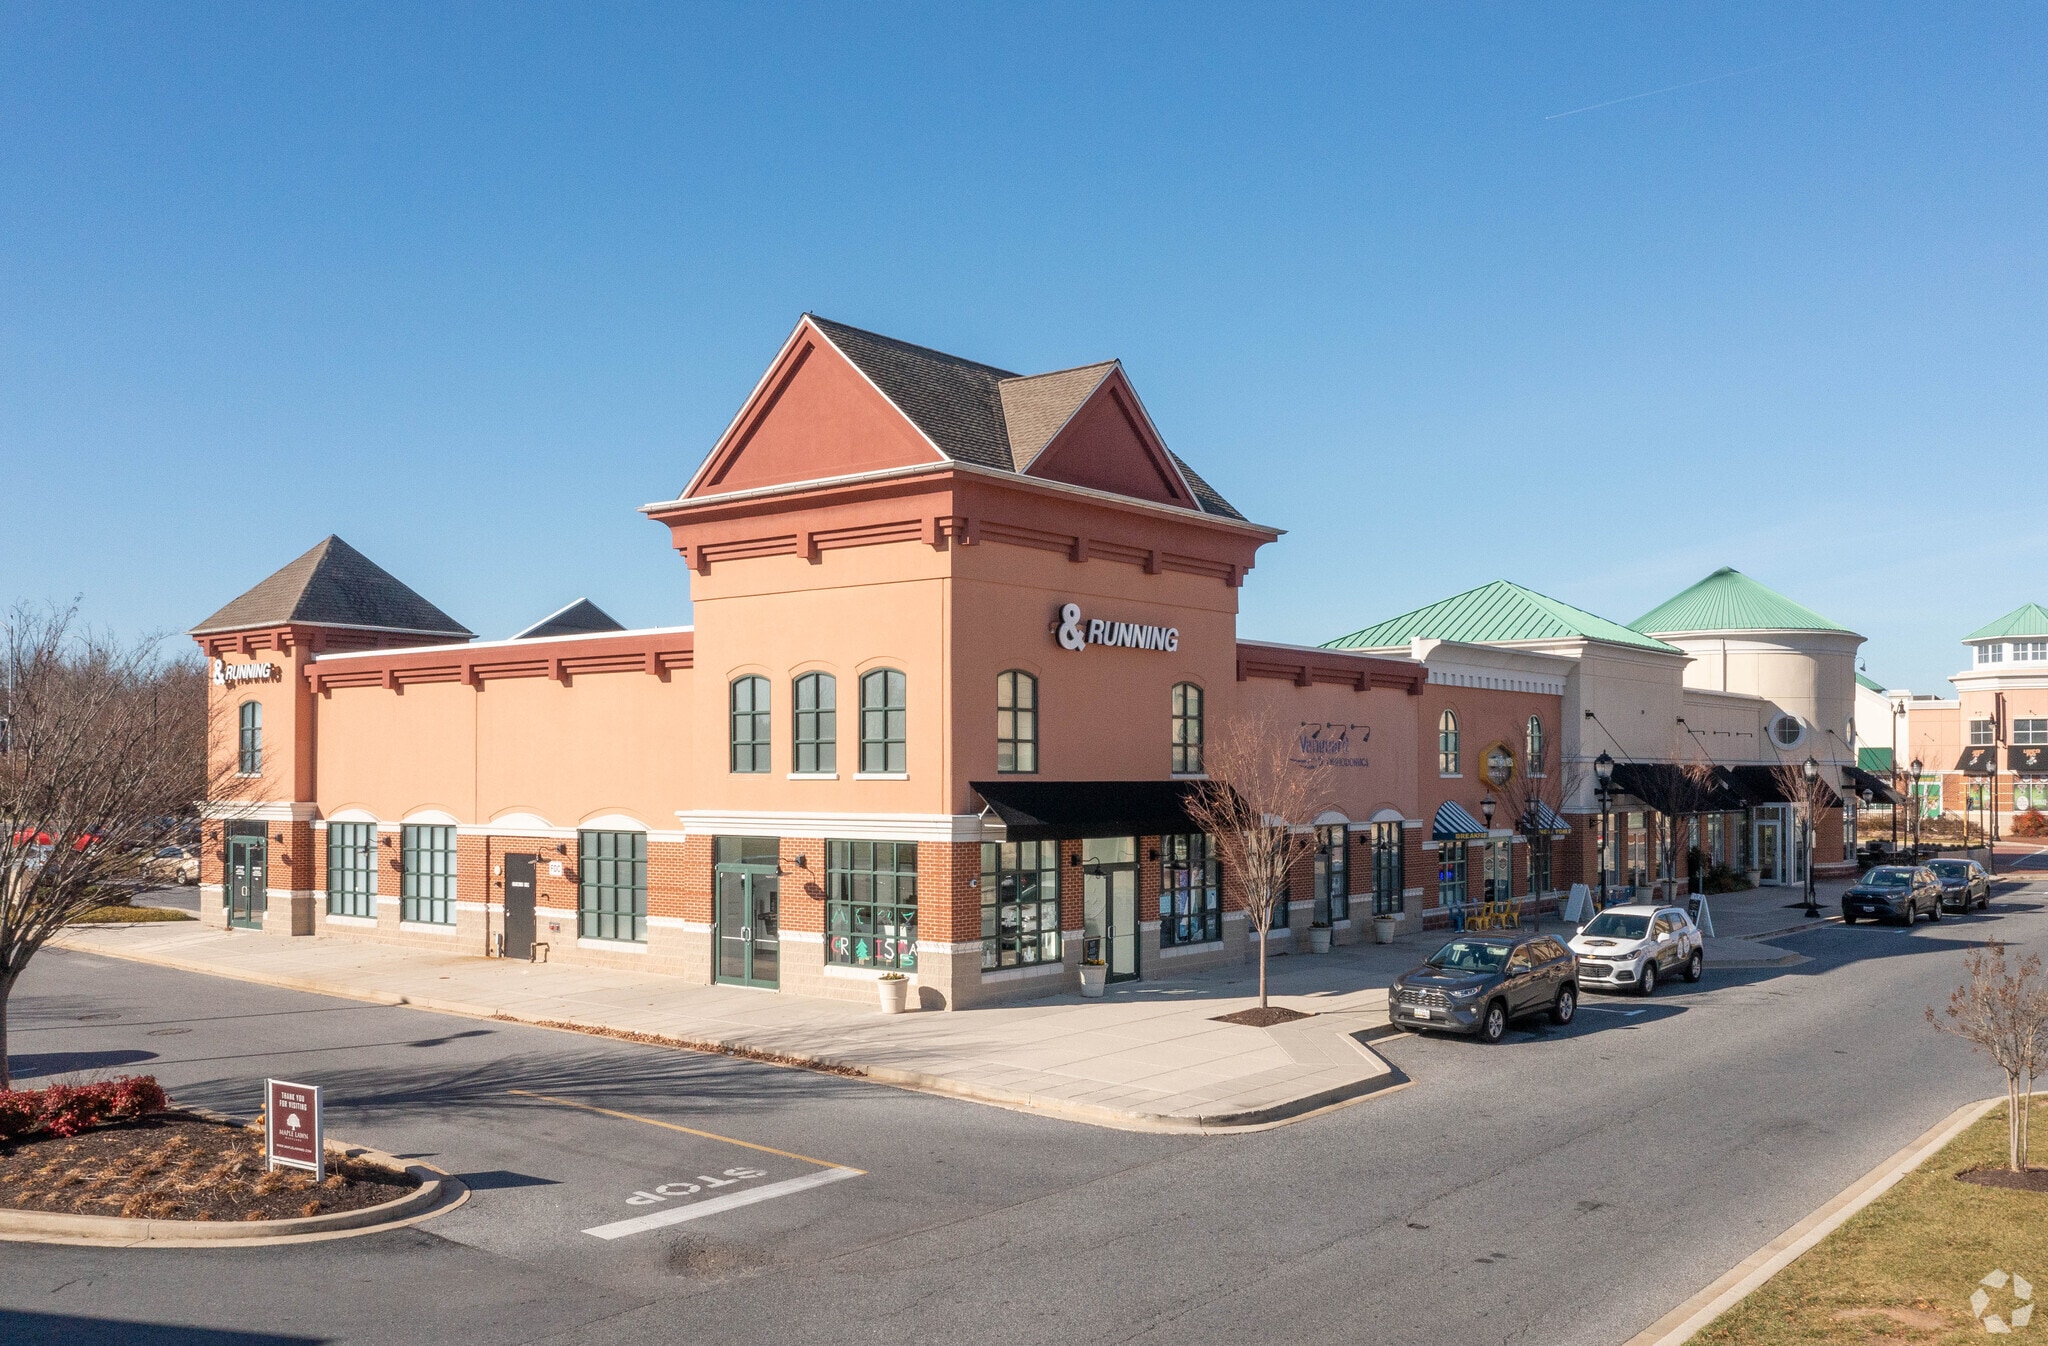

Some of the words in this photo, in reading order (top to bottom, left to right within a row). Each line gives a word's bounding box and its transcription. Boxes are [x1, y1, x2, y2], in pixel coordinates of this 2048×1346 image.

[1057, 603, 1086, 652] &
[1087, 619, 1179, 652] RUNNING
[213, 659, 225, 686] &
[225, 662, 271, 680] RUNNING
[279, 1099, 288, 1107] FOR
[288, 1101, 307, 1111] VISITING
[281, 1092, 295, 1101] THANK
[296, 1094, 305, 1103] YOU
[279, 1129, 294, 1137] MAPLE
[294, 1131, 309, 1139] LAWN
[625, 1166, 768, 1205] STOP
